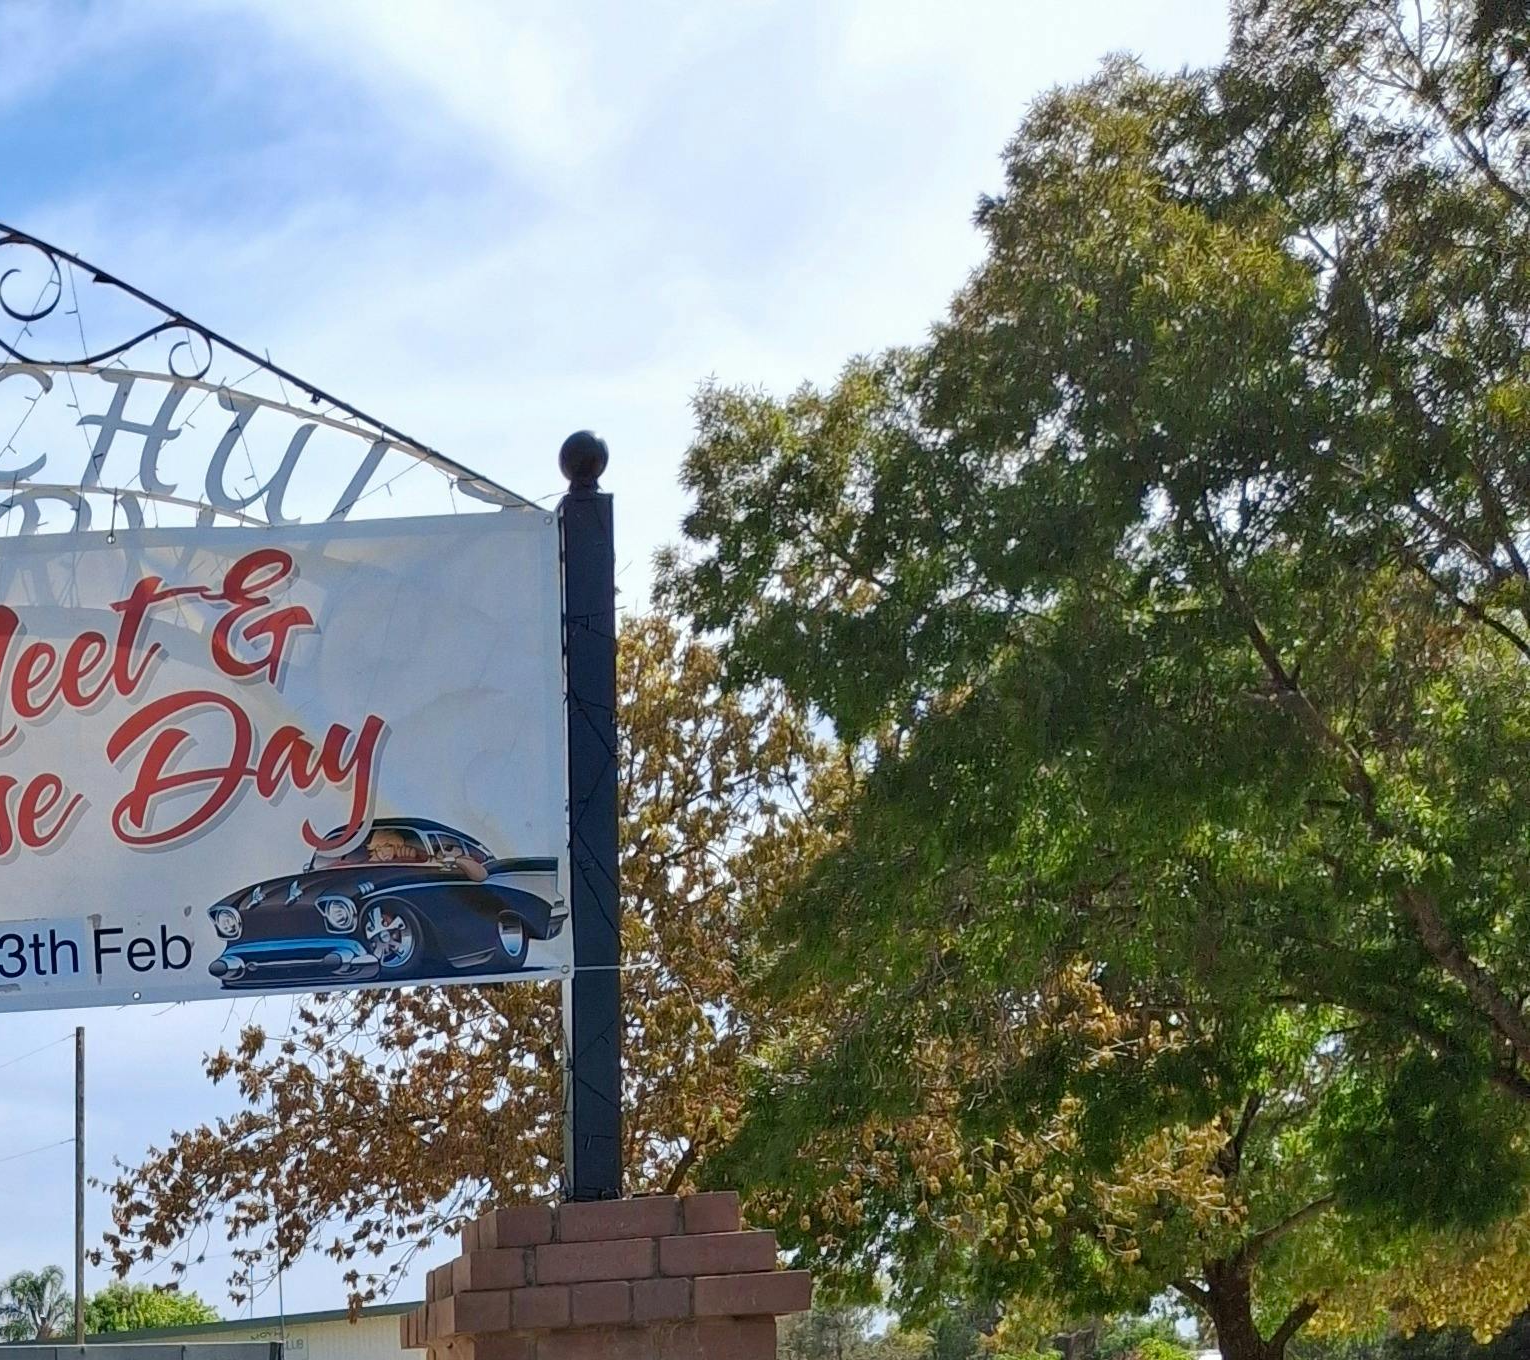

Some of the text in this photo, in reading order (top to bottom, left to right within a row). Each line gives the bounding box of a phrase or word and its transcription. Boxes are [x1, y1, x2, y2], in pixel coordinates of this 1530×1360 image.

[202, 547, 318, 684] &
[105, 690, 387, 853] Day
[92, 924, 195, 976] Feb
